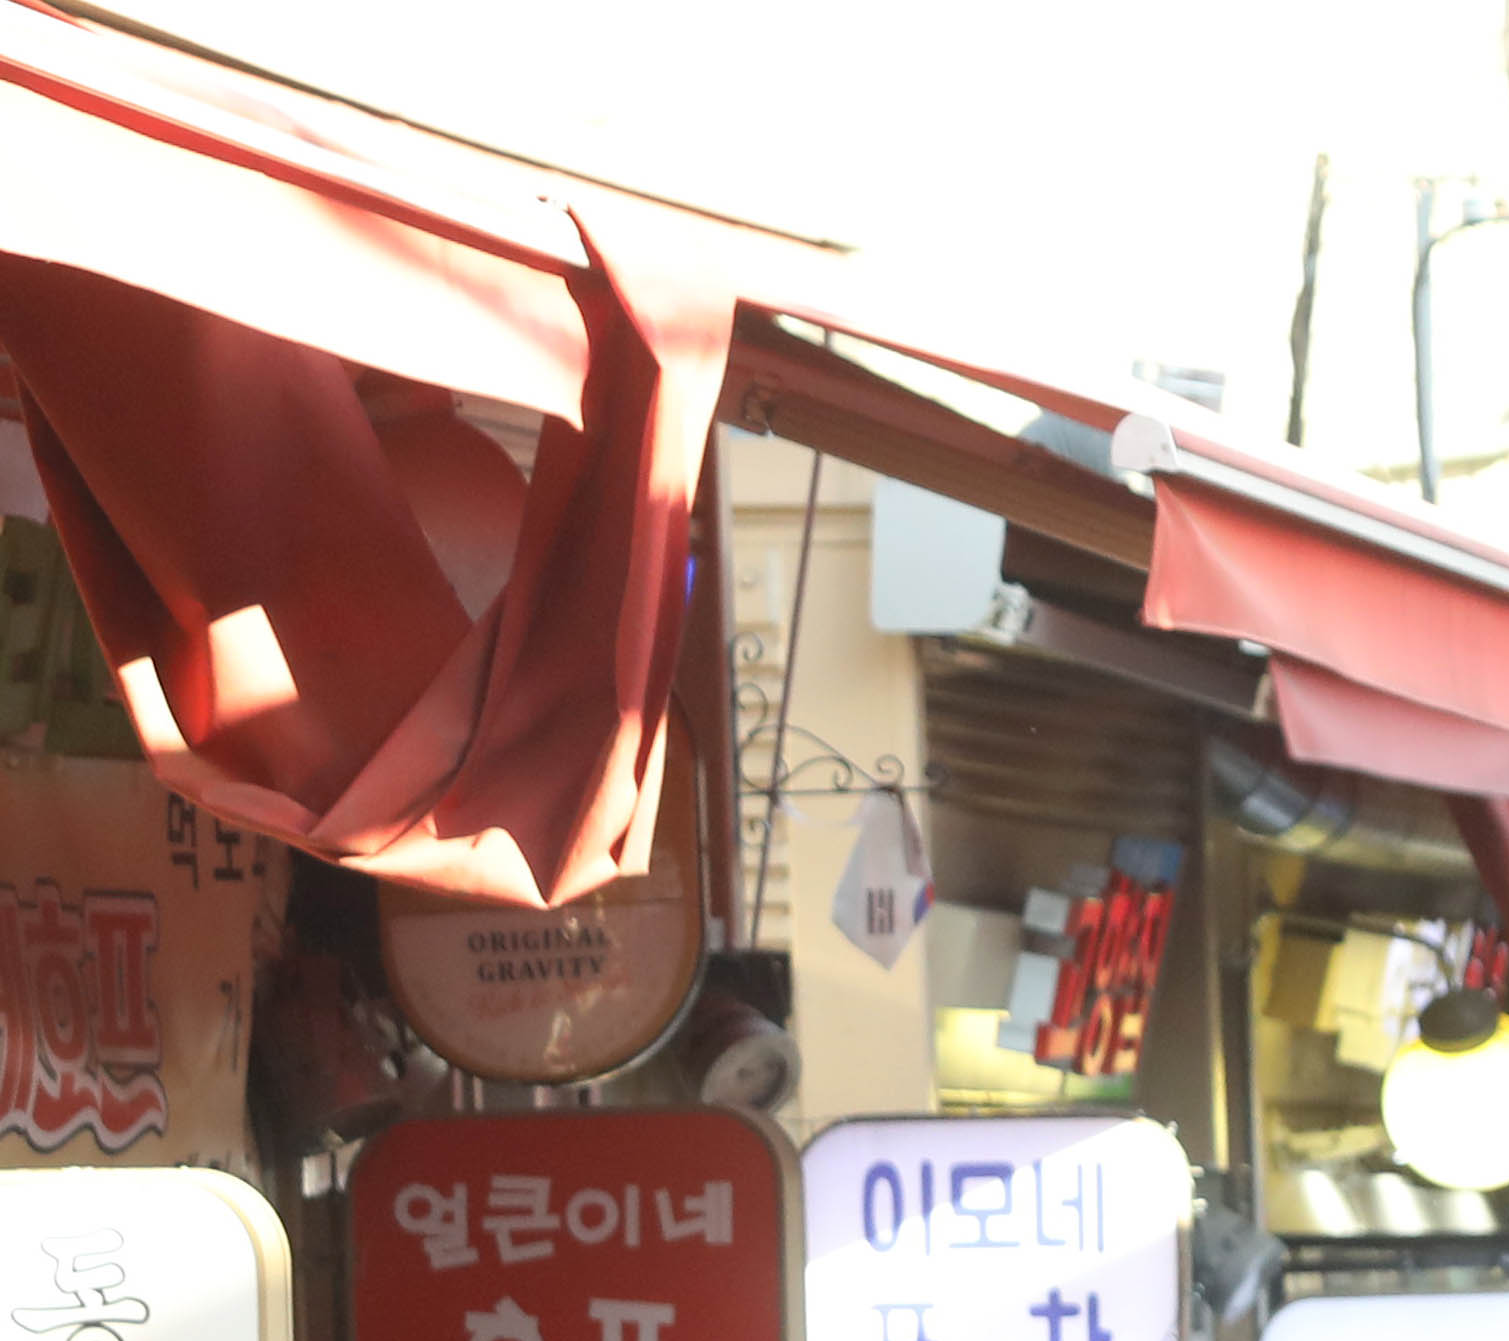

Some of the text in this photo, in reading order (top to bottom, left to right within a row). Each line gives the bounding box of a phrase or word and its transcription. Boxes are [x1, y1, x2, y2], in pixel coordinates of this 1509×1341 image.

[467, 927, 611, 953] ORIGINAL
[477, 954, 608, 983] GRAVITY
[862, 1158, 1105, 1257] 이모네
